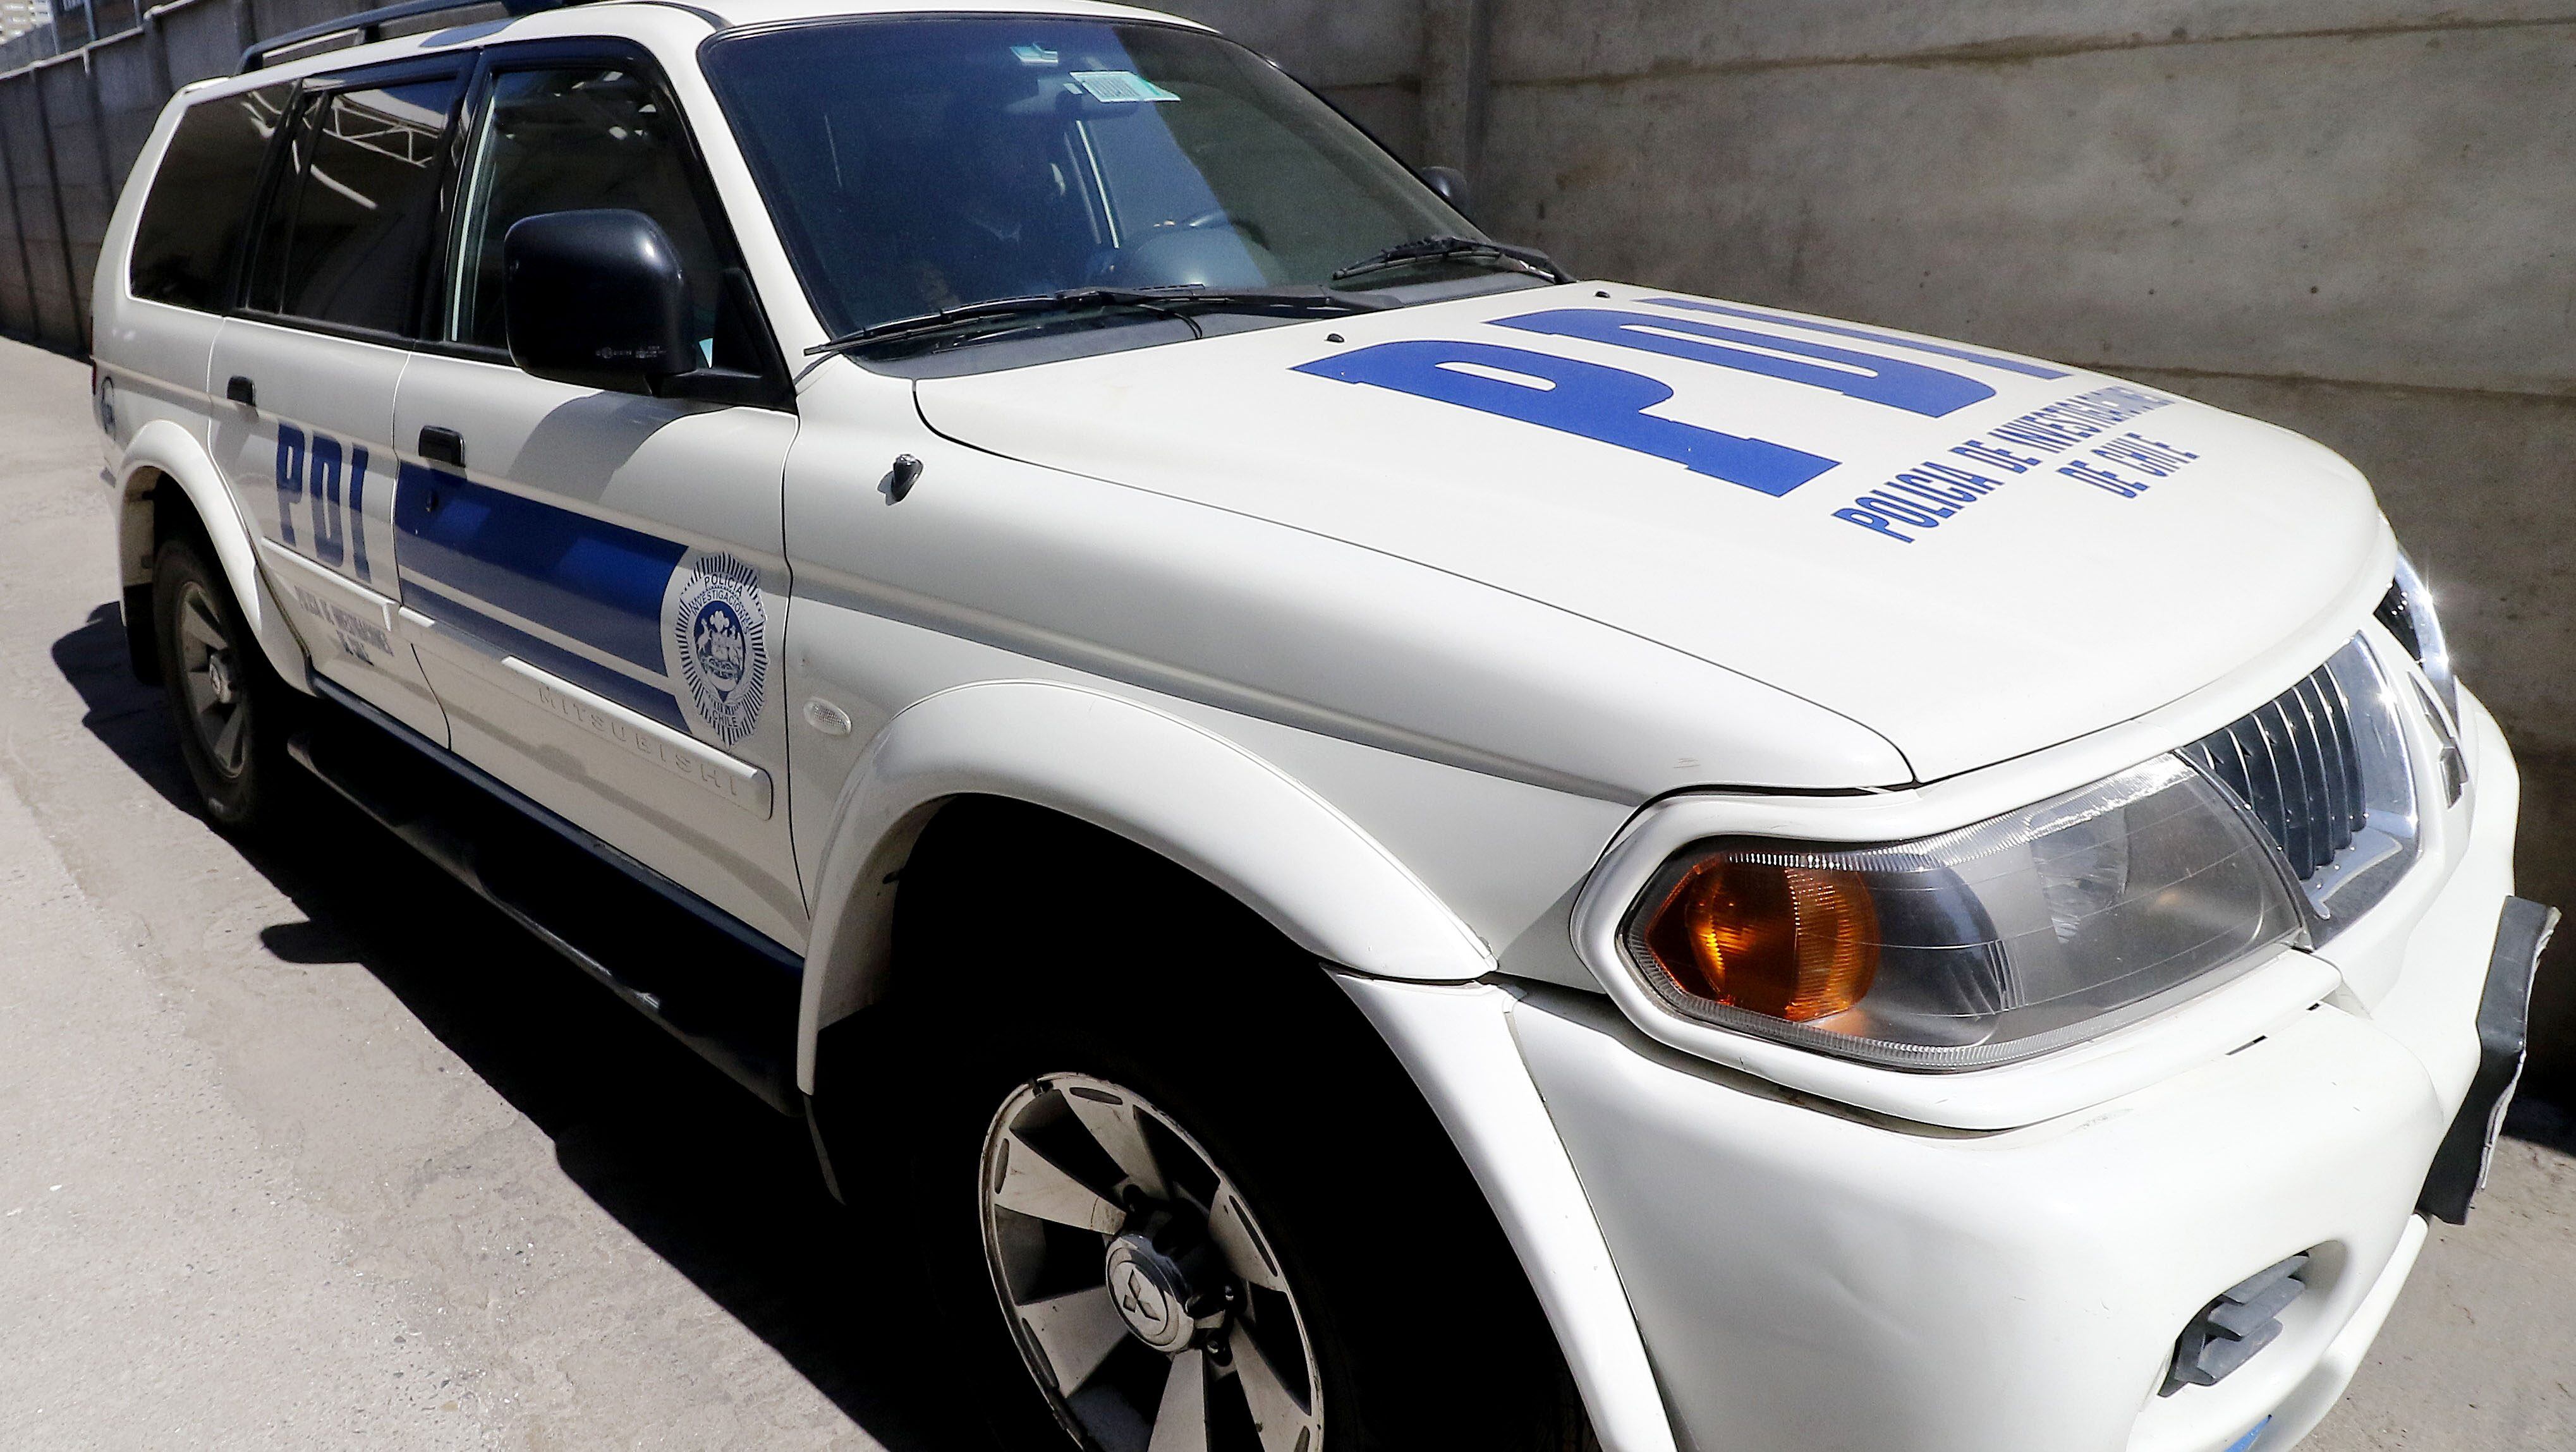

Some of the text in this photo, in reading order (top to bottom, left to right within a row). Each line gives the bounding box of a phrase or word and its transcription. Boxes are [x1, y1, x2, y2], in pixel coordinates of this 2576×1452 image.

[1287, 298, 2074, 498] PDI
[276, 420, 372, 583] PDI
[1831, 385, 2177, 543] POLICIA DE INVESTIGAC
[2055, 432, 2201, 498] DE CHILE
[691, 588, 750, 635] INVESTIGACIONES
[704, 574, 743, 597] POLICIA
[538, 684, 738, 797] MITSUBISHI
[712, 710, 738, 727] CHILE
